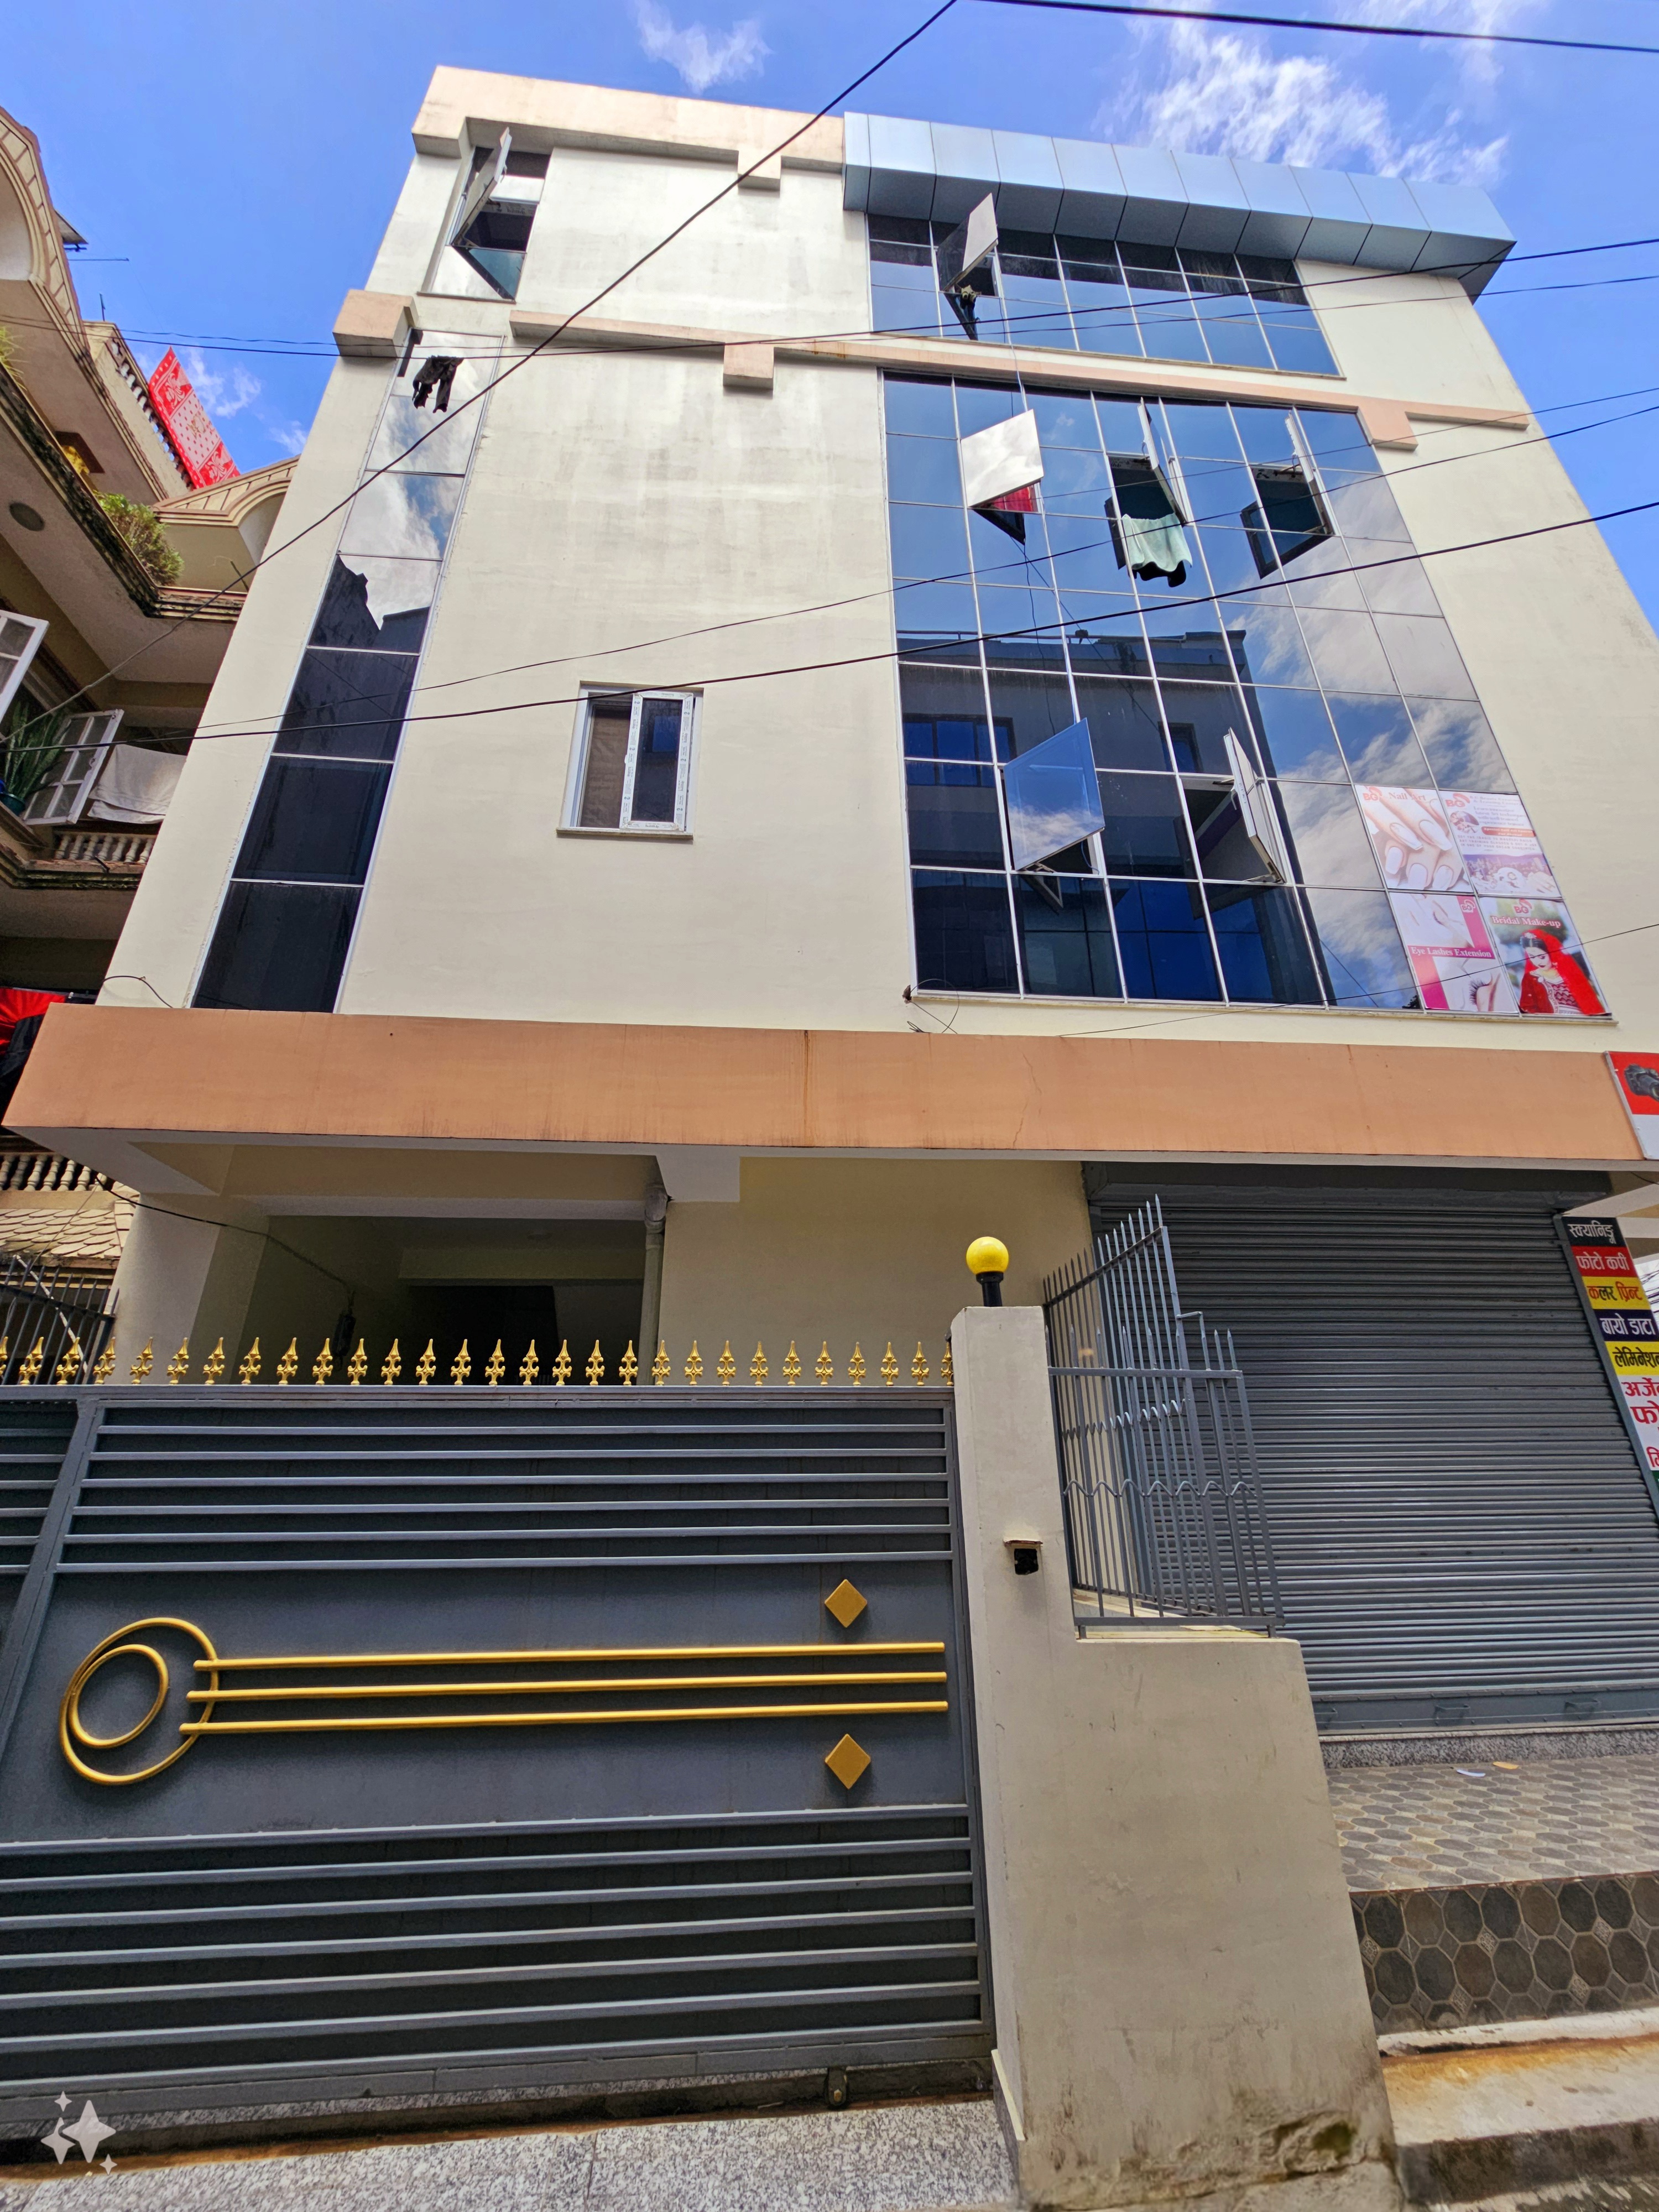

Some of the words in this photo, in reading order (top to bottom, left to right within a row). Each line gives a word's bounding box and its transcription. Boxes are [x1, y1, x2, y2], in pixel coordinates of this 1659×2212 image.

[1491, 916, 1520, 925] Bridal
[1521, 918, 1561, 928] Make-up
[1411, 947, 1426, 955] Eye
[1427, 947, 1453, 956] Lashes
[1454, 948, 1492, 958] Extension
[1575, 1251, 1605, 1270] फोटो
[1605, 1252, 1630, 1270] कपी
[1587, 1286, 1618, 1301] कलर
[1615, 1281, 1642, 1302] प्रिन्ट
[1599, 1313, 1629, 1335] बायो
[1627, 1318, 1656, 1335] डाटा
